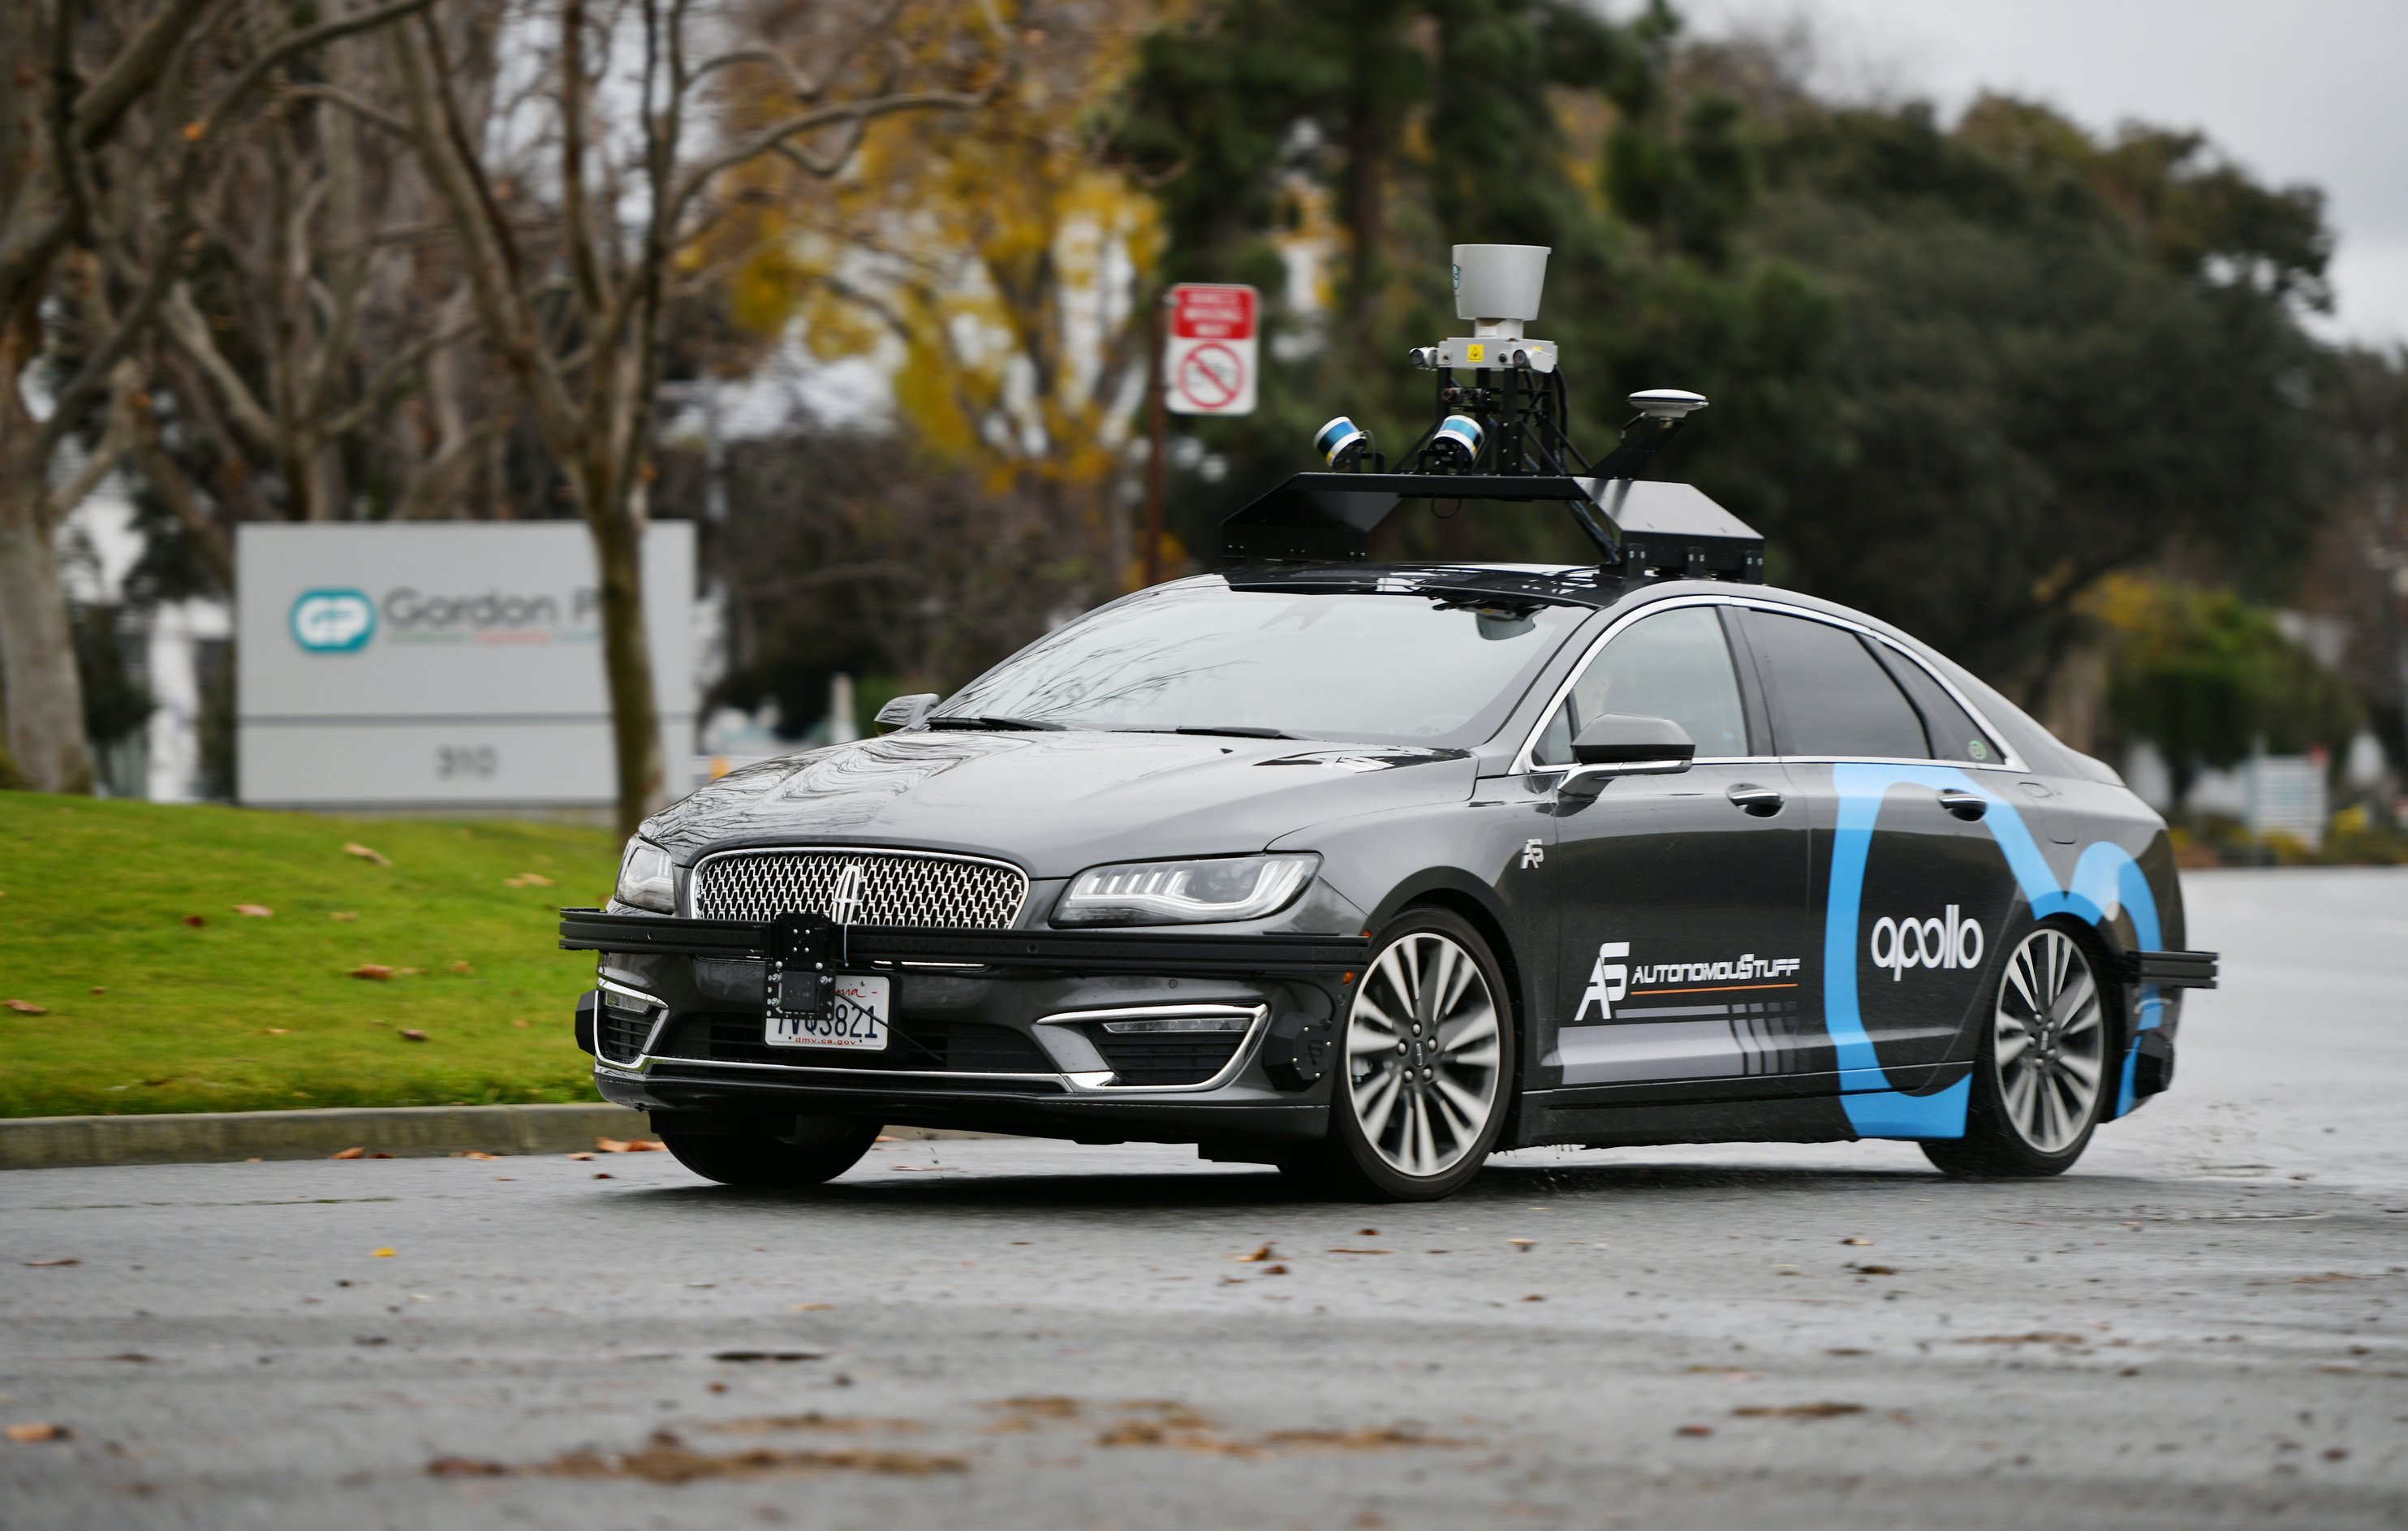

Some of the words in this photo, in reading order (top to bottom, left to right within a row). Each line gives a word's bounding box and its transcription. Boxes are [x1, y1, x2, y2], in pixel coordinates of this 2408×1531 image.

[383, 586, 557, 628] Gordon
[1871, 904, 1984, 981] apollo
[1574, 942, 1630, 1021] AS
[795, 1037, 857, 1046] dmv.ca.gov
